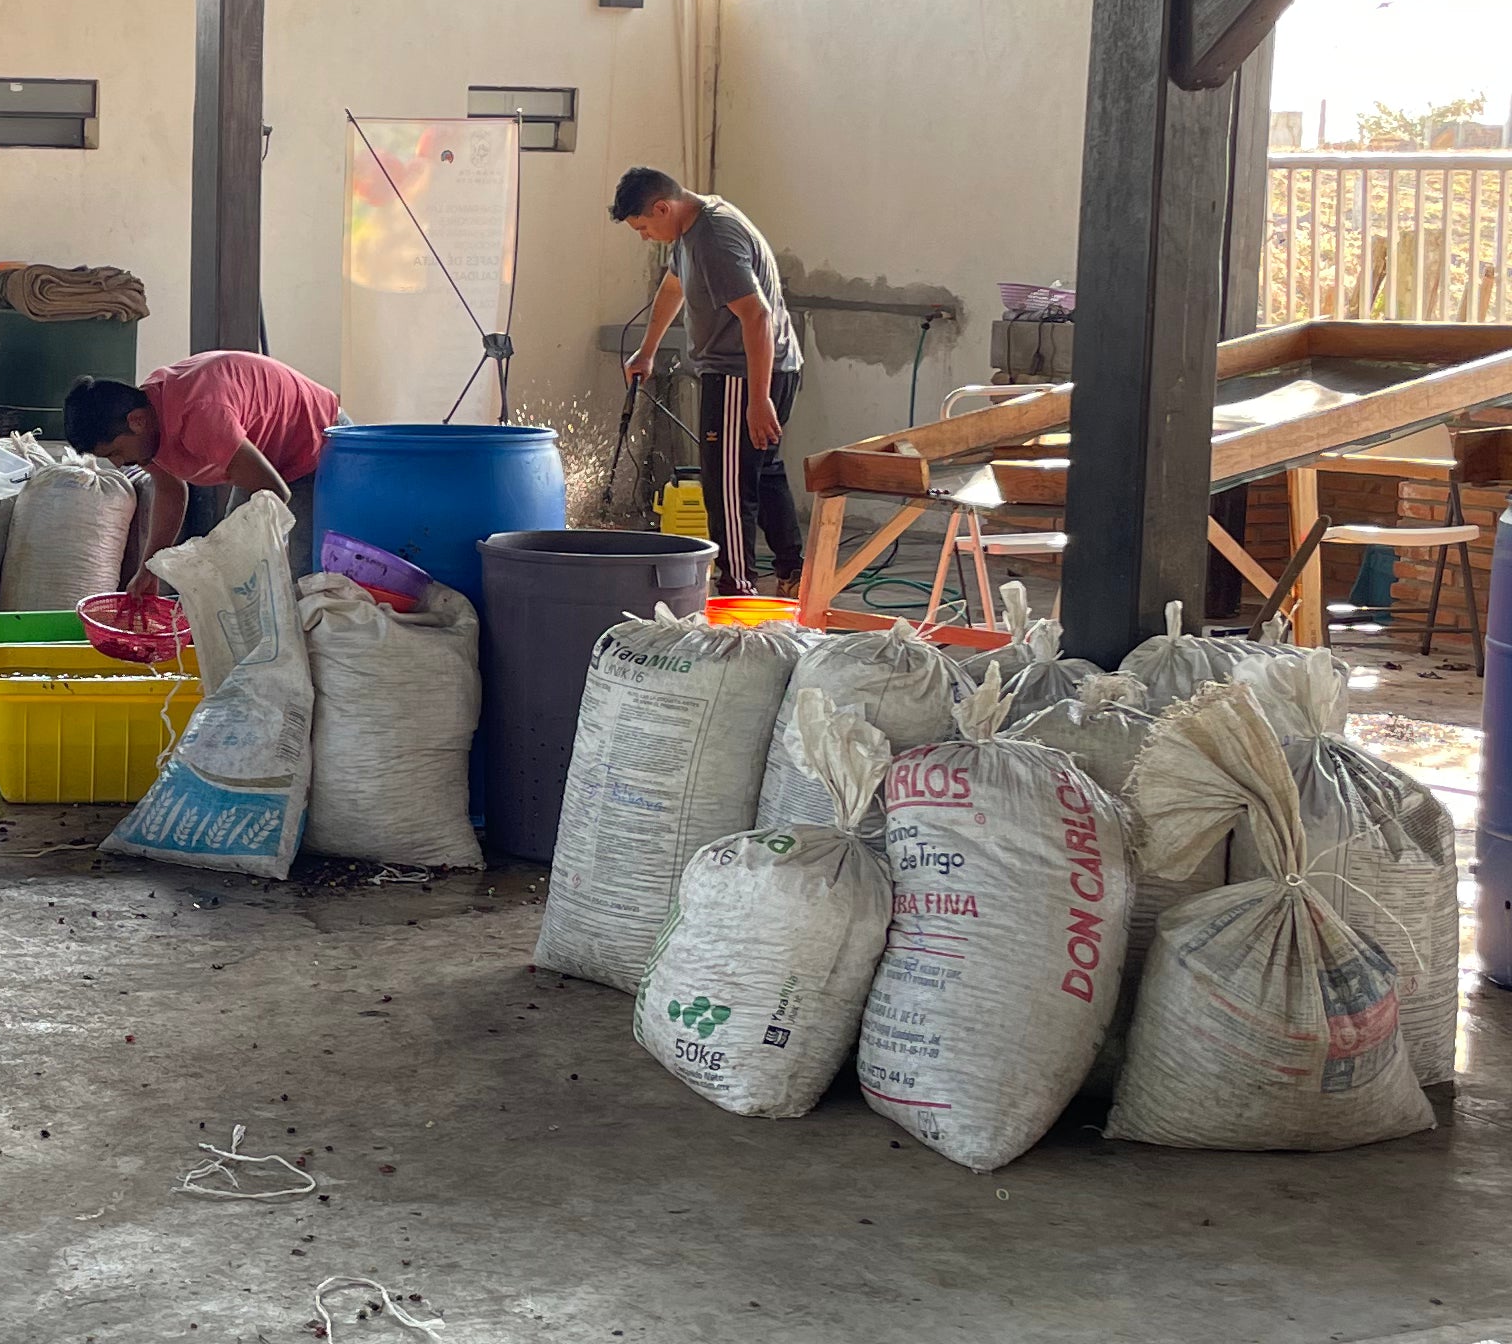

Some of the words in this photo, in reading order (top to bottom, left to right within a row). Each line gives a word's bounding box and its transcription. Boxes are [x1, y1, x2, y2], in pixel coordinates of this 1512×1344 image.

[916, 842, 965, 875] Trigo
[924, 892, 979, 918] FINA
[1060, 907, 1105, 1004] DON
[674, 1037, 725, 1071] 50kg
